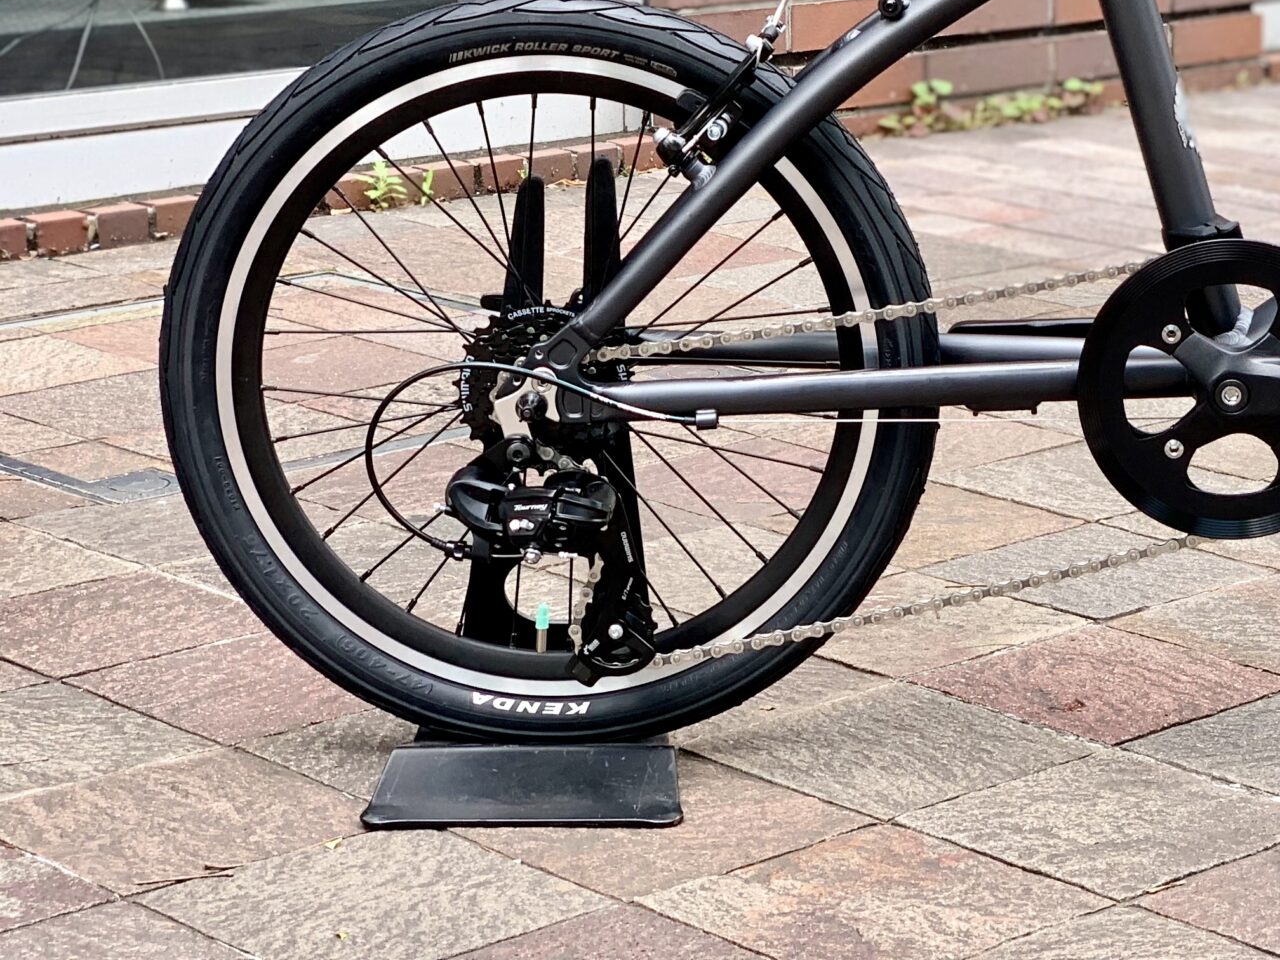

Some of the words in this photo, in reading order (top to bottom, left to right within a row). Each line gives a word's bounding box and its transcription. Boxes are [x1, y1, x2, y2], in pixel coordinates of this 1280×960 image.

[464, 43, 512, 60] KWICK
[515, 42, 567, 51] ROLLER
[571, 44, 620, 58] SPORT
[507, 306, 545, 320] CASSETTE
[546, 307, 576, 317] SPROCKETS
[472, 691, 591, 715] KENDA
